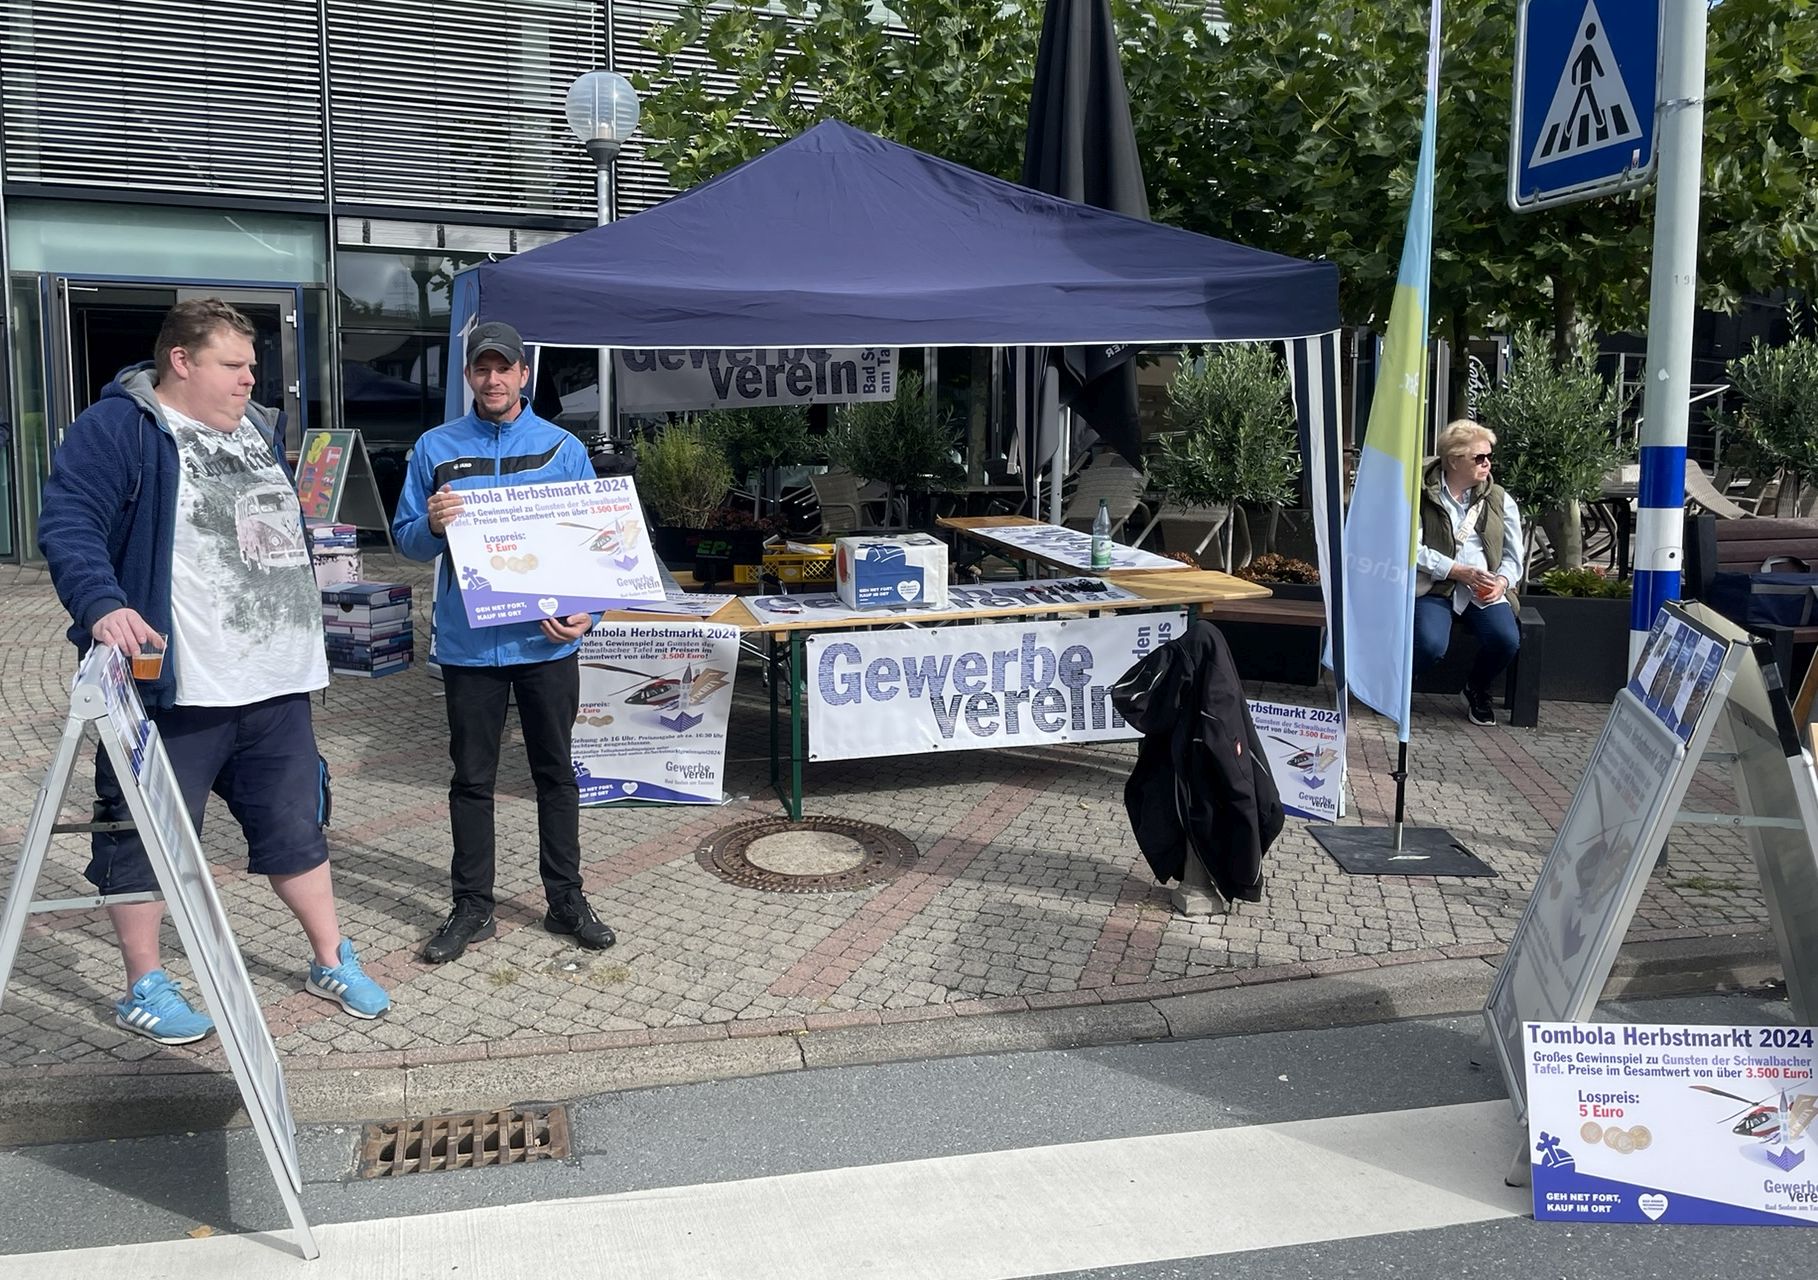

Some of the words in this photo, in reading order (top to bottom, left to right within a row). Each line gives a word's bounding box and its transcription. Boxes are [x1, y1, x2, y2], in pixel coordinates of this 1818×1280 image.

[861, 348, 875, 361] S
[877, 349, 890, 367] Ta
[708, 360, 857, 400] verein
[862, 366, 876, 394] Bad
[881, 372, 890, 393] am
[463, 490, 502, 505] mbola
[505, 482, 591, 502] Herbstmarkt
[594, 478, 629, 494] 2024
[473, 517, 498, 526] Preise
[500, 515, 509, 523] im
[511, 510, 555, 522] Gesamtwert
[557, 510, 570, 519] von
[572, 508, 588, 517] über
[590, 505, 612, 514] 3.500
[613, 503, 633, 512] Euro!
[477, 505, 523, 516] Gewinnspiel
[535, 502, 566, 512] Gunsten
[567, 500, 579, 509] der
[483, 532, 526, 544] Lospreis:
[486, 544, 493, 554] 5
[496, 543, 518, 552] Euro
[583, 627, 626, 638] ombola
[630, 627, 703, 638] Herbstmarkt
[707, 628, 737, 639] 2024
[1158, 622, 1172, 644] us
[1132, 626, 1151, 660] den
[817, 632, 1094, 706] Gewerbe
[929, 685, 1127, 739] verein
[1247, 703, 1307, 719] erbstmarkt
[1310, 710, 1341, 724] 2024
[1299, 729, 1319, 738] 3.500
[1320, 732, 1338, 741] Euro!
[665, 761, 711, 773] Gewerbe
[683, 769, 715, 780] verein
[1527, 1024, 1616, 1045] Tombola
[1623, 1026, 1753, 1048] Herbstmarkt
[1759, 1029, 1814, 1048] 2024
[1533, 1051, 1573, 1063] Großes
[1576, 1052, 1643, 1066] Gewinnspiel
[1646, 1056, 1659, 1065] zu
[1662, 1054, 1711, 1066] Gunsten
[1711, 1055, 1731, 1066] der
[1733, 1055, 1812, 1067] Schwalbacher
[1532, 1063, 1564, 1075] Tafel.
[1568, 1064, 1603, 1075] Preise
[1606, 1065, 1620, 1076] im
[1623, 1065, 1690, 1077] Gesamtwert
[1693, 1069, 1713, 1078] von
[1717, 1067, 1743, 1078] über
[1745, 1067, 1780, 1079] 3.500
[1783, 1068, 1814, 1079] Euro!
[1578, 1089, 1640, 1105] Lospreis:
[1579, 1104, 1588, 1117] 5
[1592, 1104, 1624, 1118] Euro
[1546, 1192, 1568, 1201] GEH
[1570, 1193, 1591, 1202] NET
[1592, 1193, 1622, 1204] FORT,
[1788, 1190, 1818, 1203] vere
[1546, 1203, 1574, 1212] KAUF
[1576, 1204, 1589, 1213] IM
[1591, 1204, 1613, 1213] ORT
